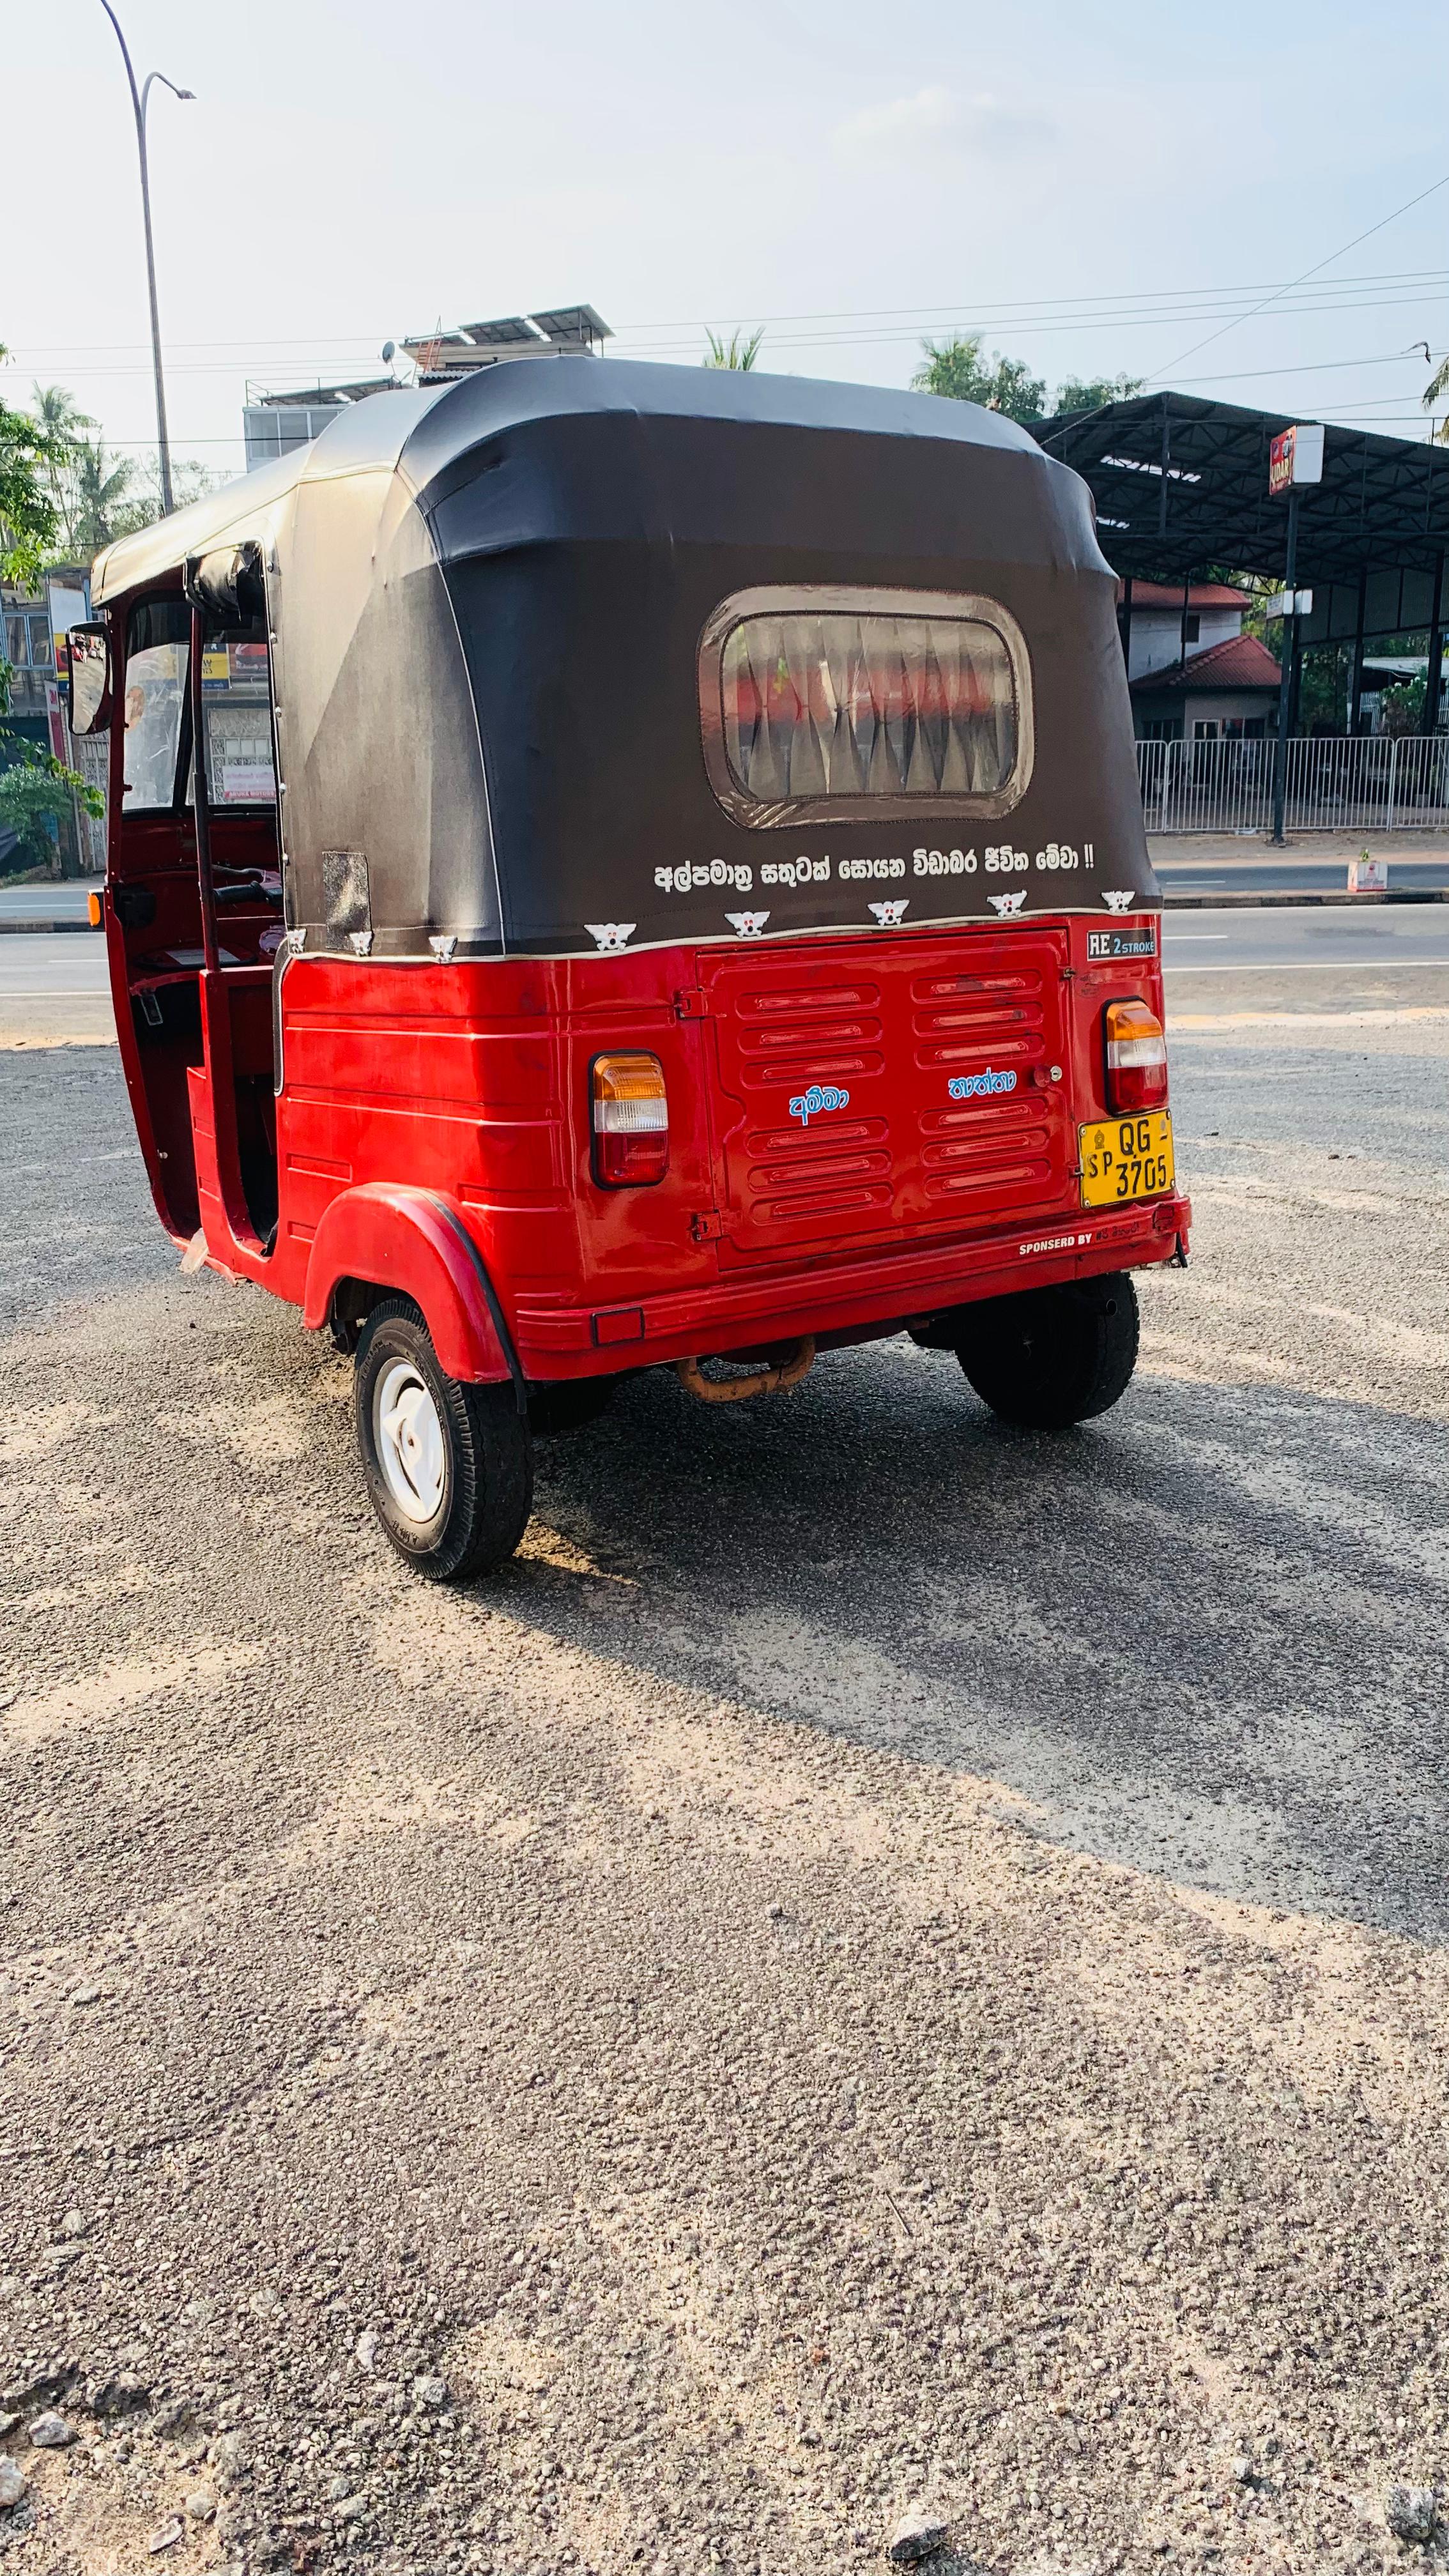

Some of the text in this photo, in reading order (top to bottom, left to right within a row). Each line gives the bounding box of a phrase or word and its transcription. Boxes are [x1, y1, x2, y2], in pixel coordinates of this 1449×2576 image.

[760, 855, 831, 887] සතුටක්
[838, 857, 906, 879] සොයන
[913, 848, 978, 876] විඩාබර
[985, 845, 1029, 873] ජීවිත
[1036, 843, 1079, 870] මේවා
[1089, 934, 1110, 955] RE
[948, 1067, 1017, 1100] තාත්තා
[789, 1085, 850, 1126] අම්මා
[1088, 1151, 1113, 1177] SP
[1116, 1154, 1167, 1197] 3705
[1019, 1232, 1092, 1255] SPONSERD BY
